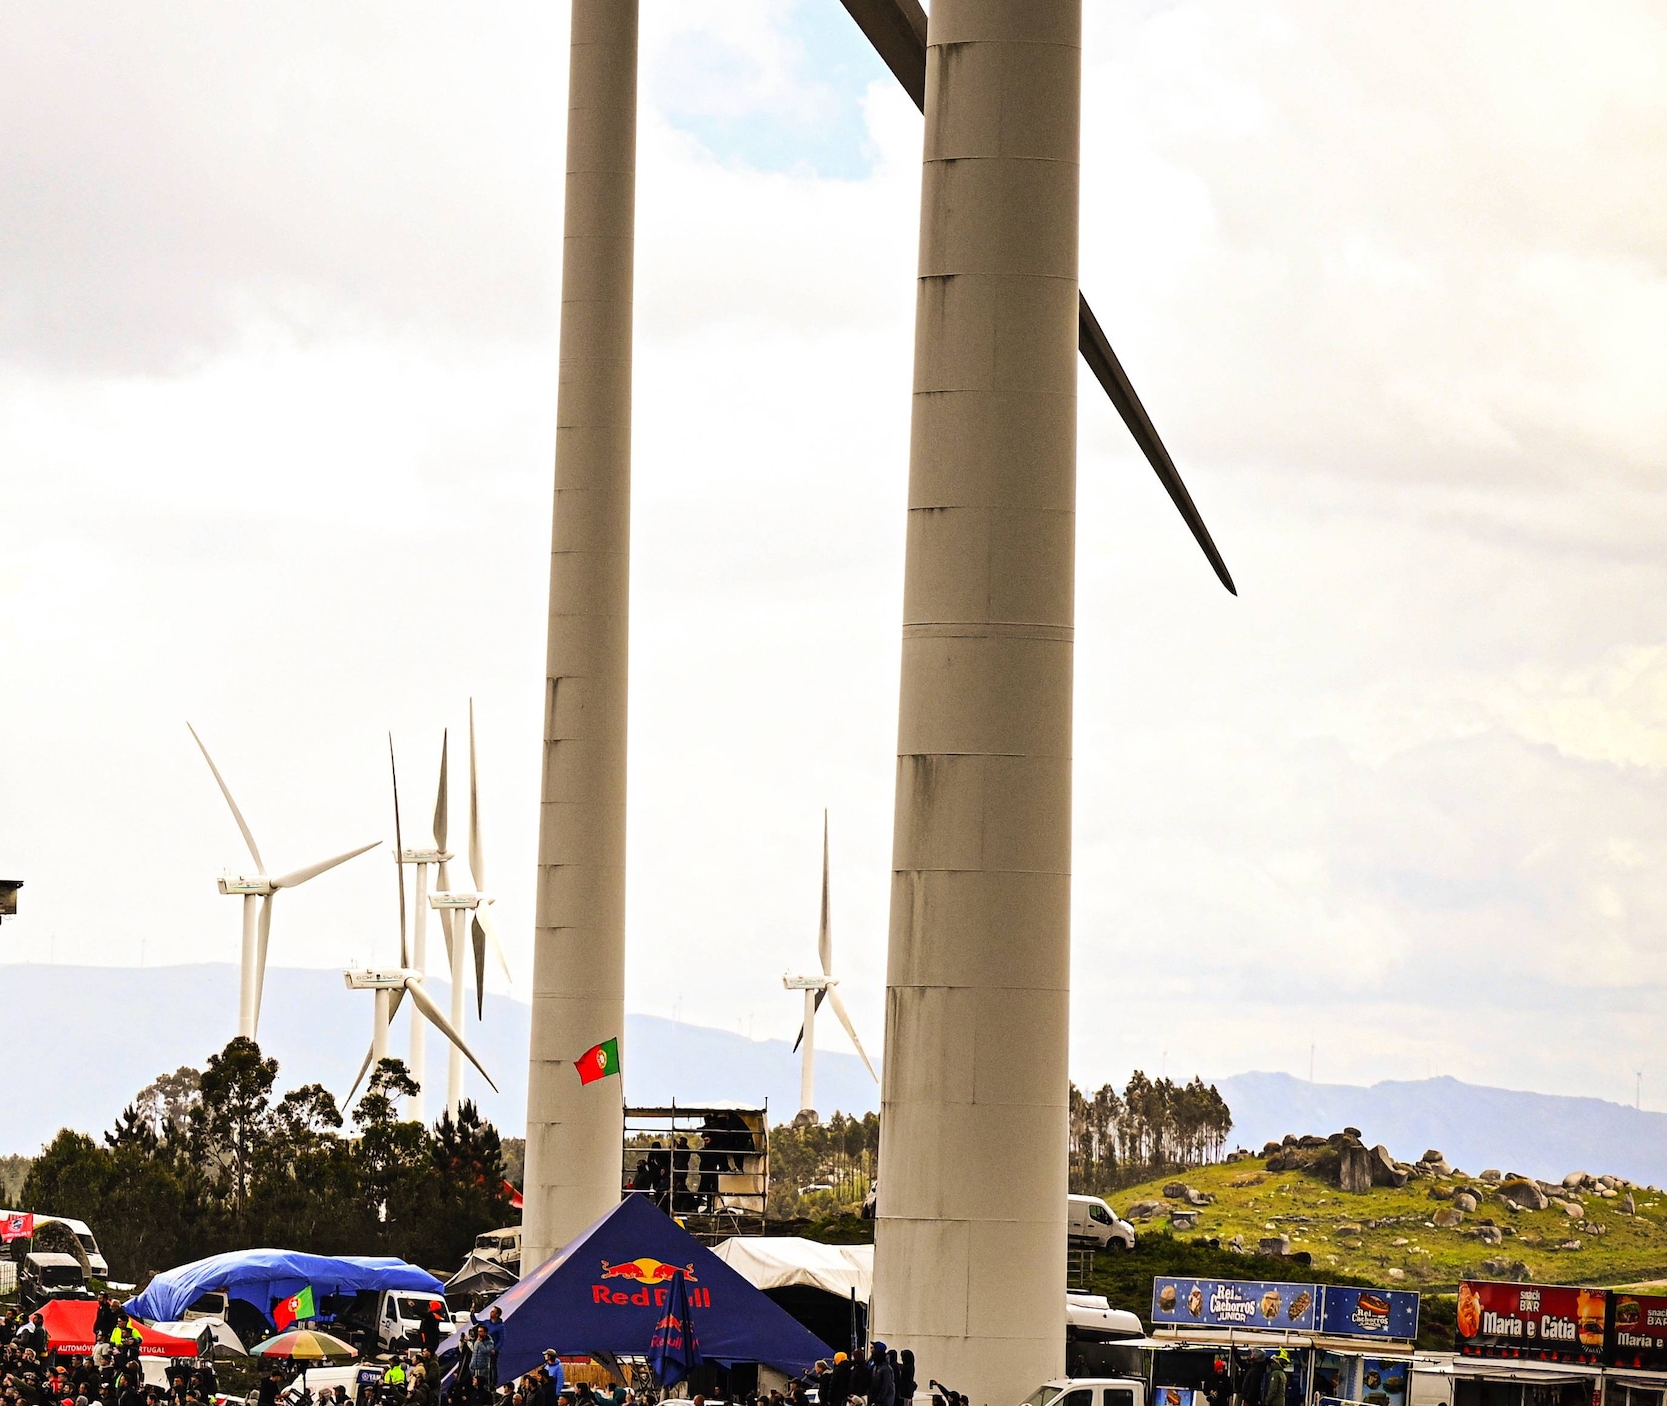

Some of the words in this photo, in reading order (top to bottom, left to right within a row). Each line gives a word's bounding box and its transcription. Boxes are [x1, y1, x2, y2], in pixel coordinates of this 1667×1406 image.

[591, 1284, 651, 1307] Red
[1217, 1284, 1235, 1300] Rei
[1520, 1290, 1541, 1301] snack
[1210, 1293, 1255, 1316] Cachorros
[1519, 1301, 1540, 1312] BAR
[1217, 1311, 1246, 1323] JUNIOR
[1482, 1311, 1523, 1337] Maria
[1526, 1319, 1536, 1336] e
[1540, 1315, 1577, 1340] Cátia
[1617, 1332, 1653, 1348] Maria
[1656, 1339, 1664, 1347] e
